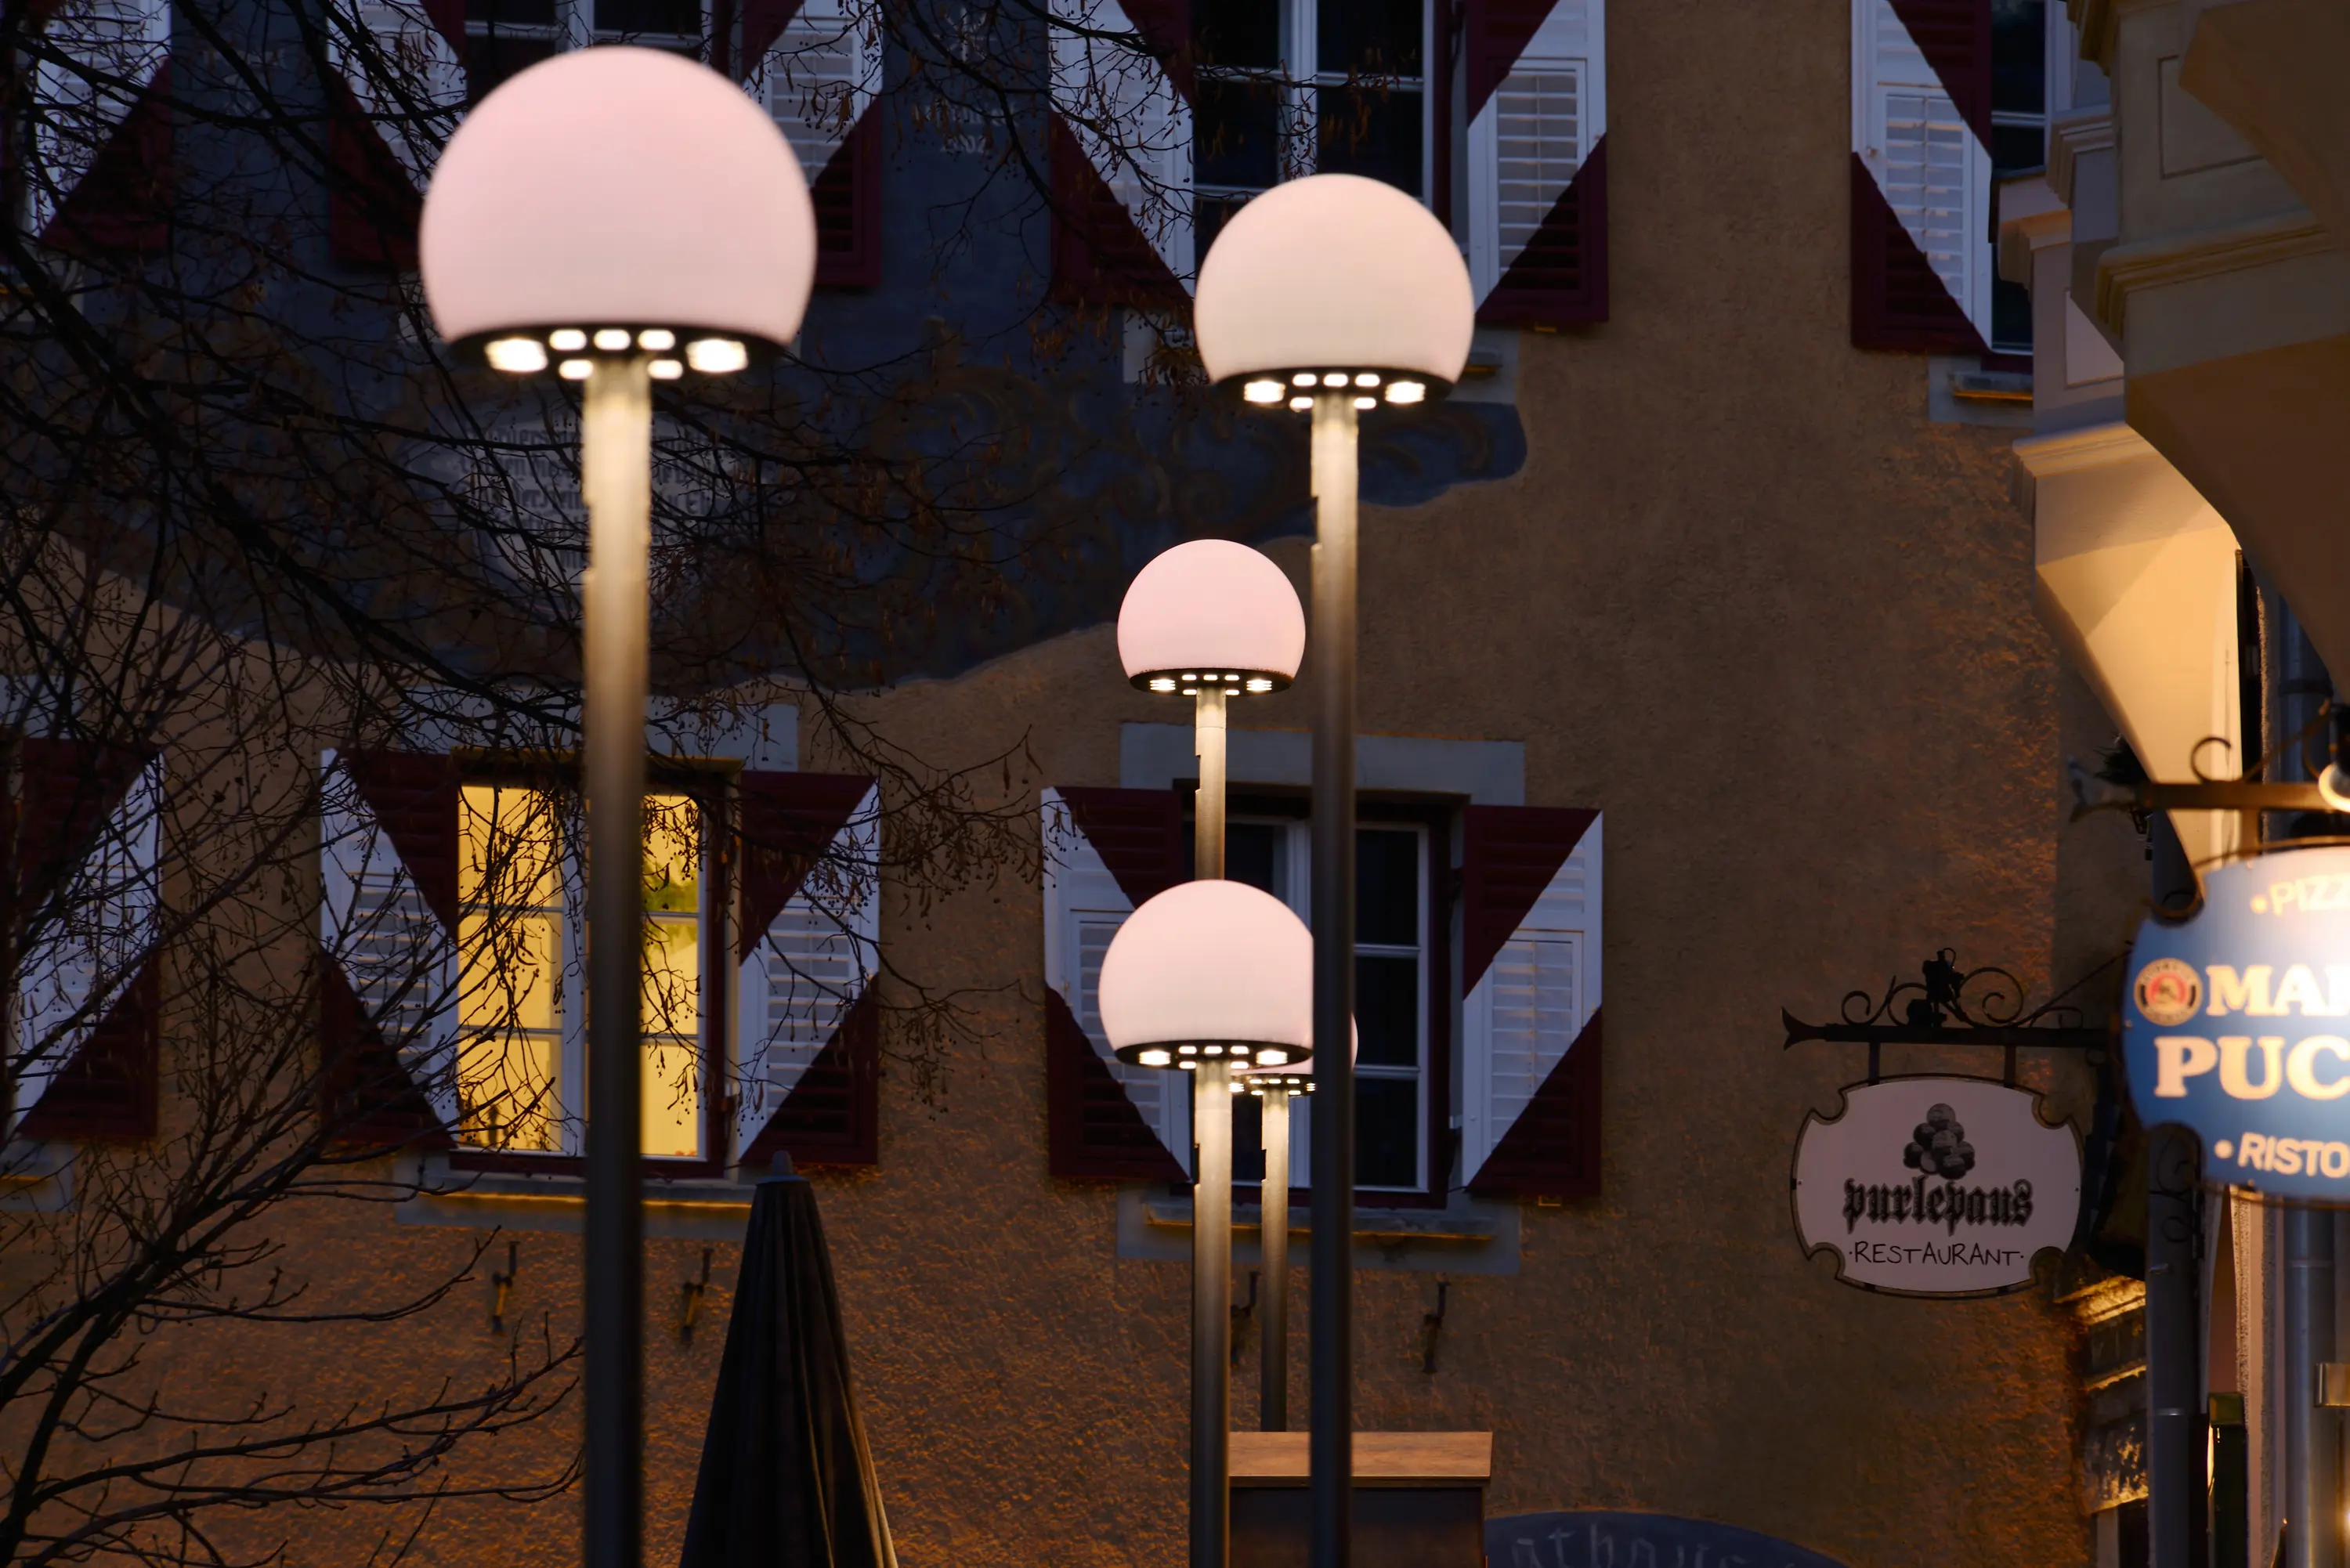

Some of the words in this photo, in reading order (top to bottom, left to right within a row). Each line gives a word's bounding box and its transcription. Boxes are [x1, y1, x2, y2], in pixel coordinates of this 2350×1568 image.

[2153, 1035, 2350, 1100] PUC
[2237, 1132, 2350, 1179] RISTO
[1853, 1241, 2020, 1266] RESTAURANT
